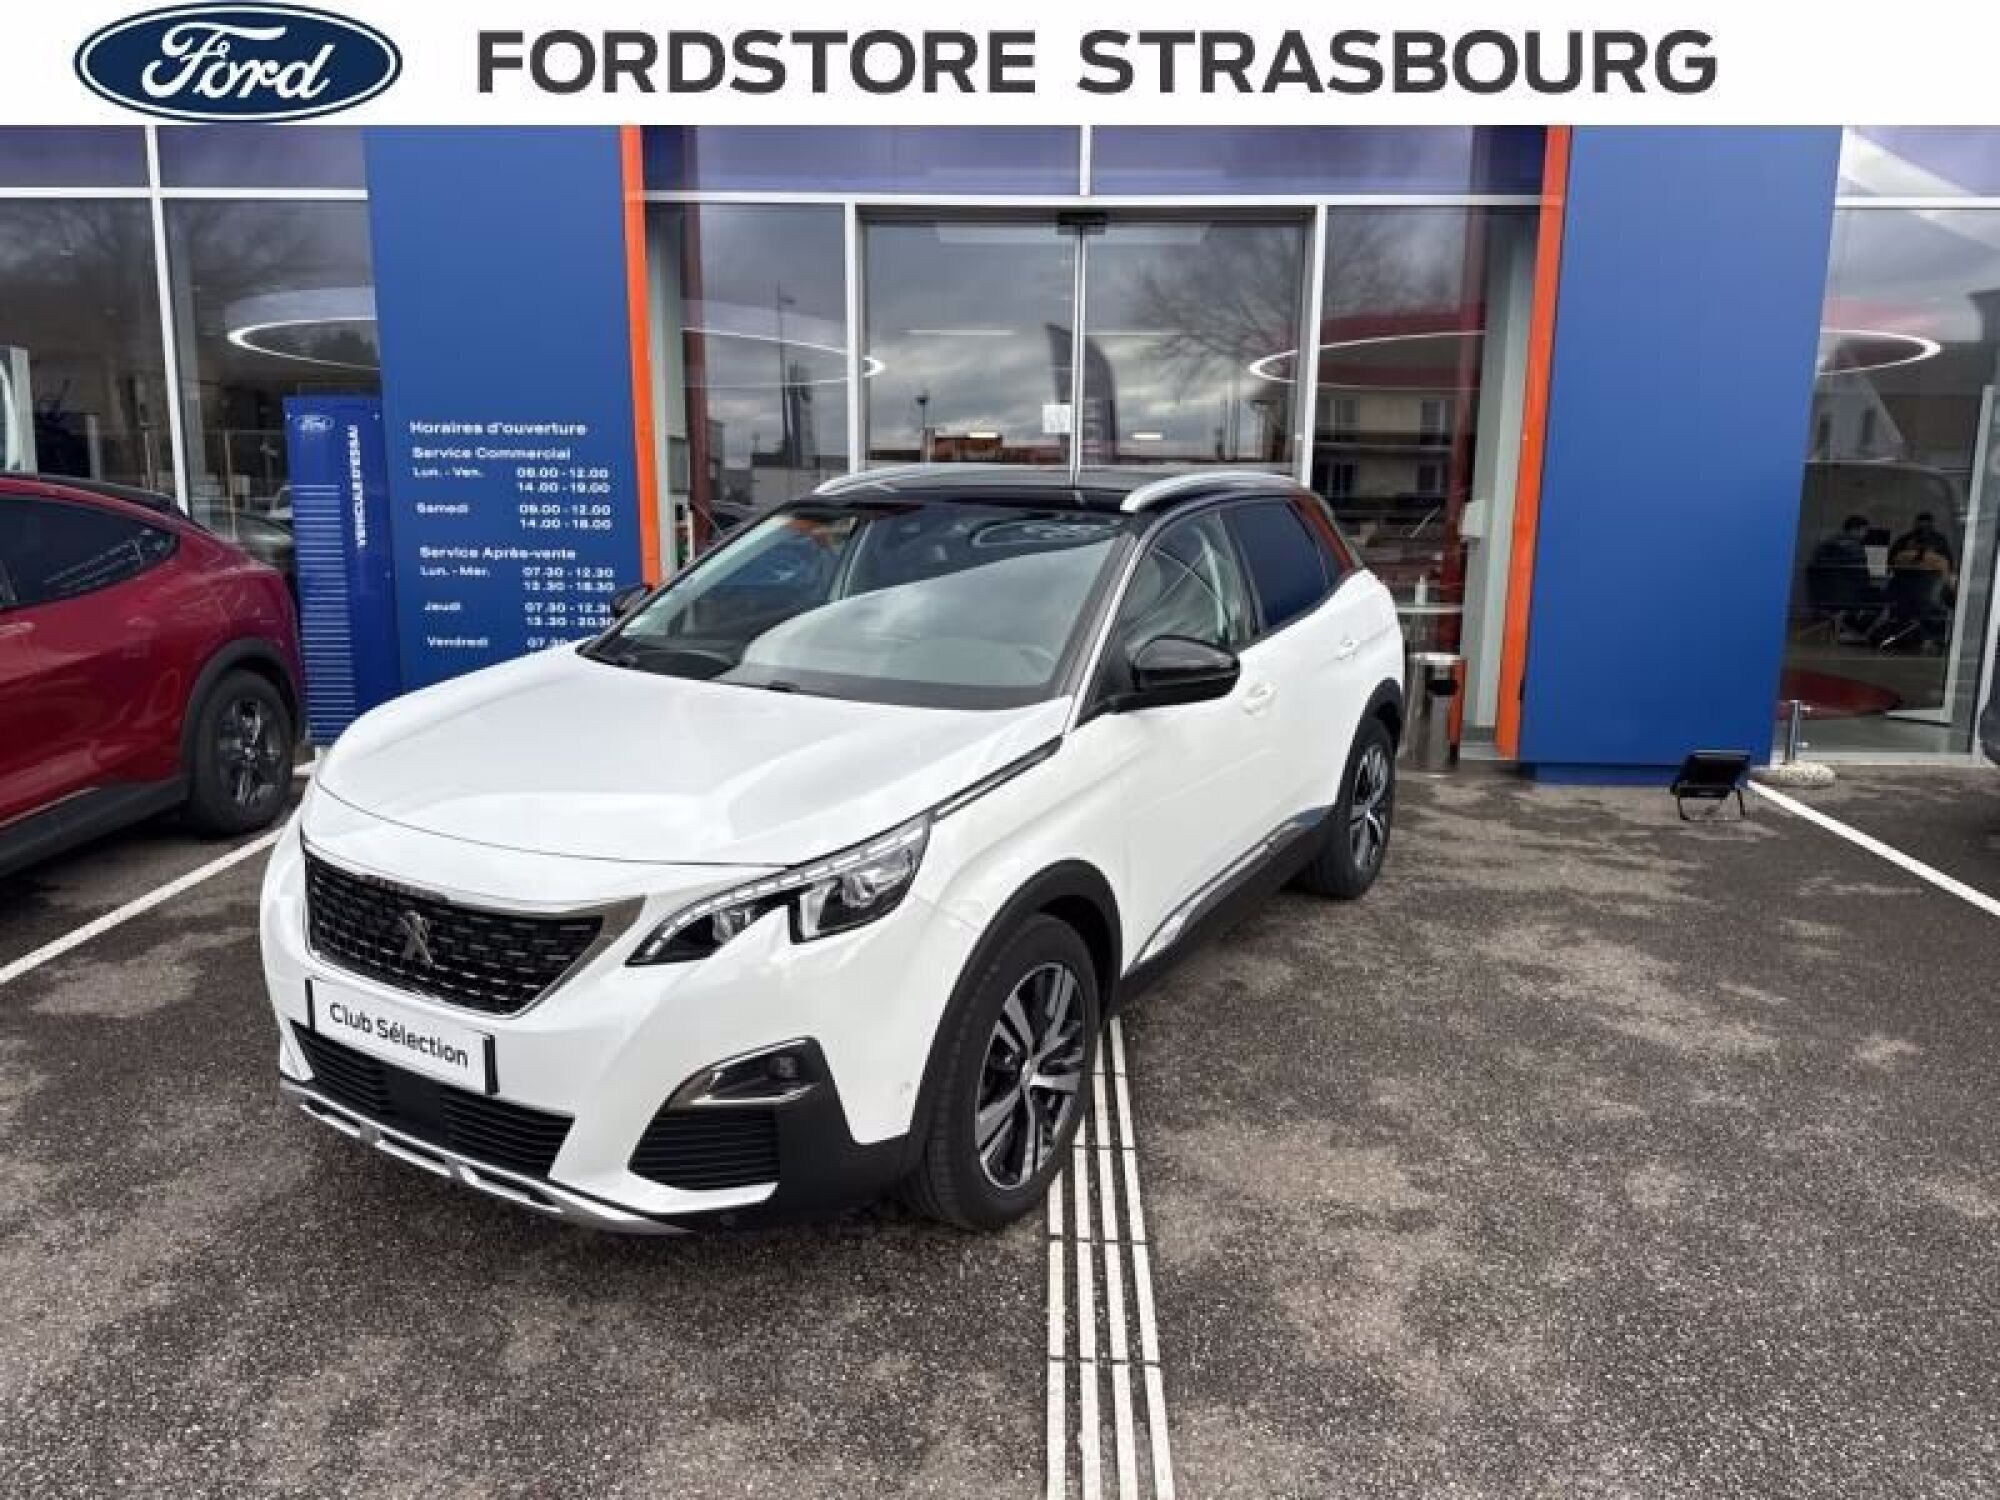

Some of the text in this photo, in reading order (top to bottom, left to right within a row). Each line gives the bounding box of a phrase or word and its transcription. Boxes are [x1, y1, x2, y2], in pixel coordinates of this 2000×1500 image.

[409, 421, 588, 436] Horaires d'ouverture
[412, 447, 571, 460] Service Commercial
[416, 502, 469, 514] Samedi
[419, 546, 479, 559] Service
[424, 601, 461, 611] Jeudi
[427, 636, 489, 648] Vendredi
[329, 1002, 469, 1069] Club Sélection
